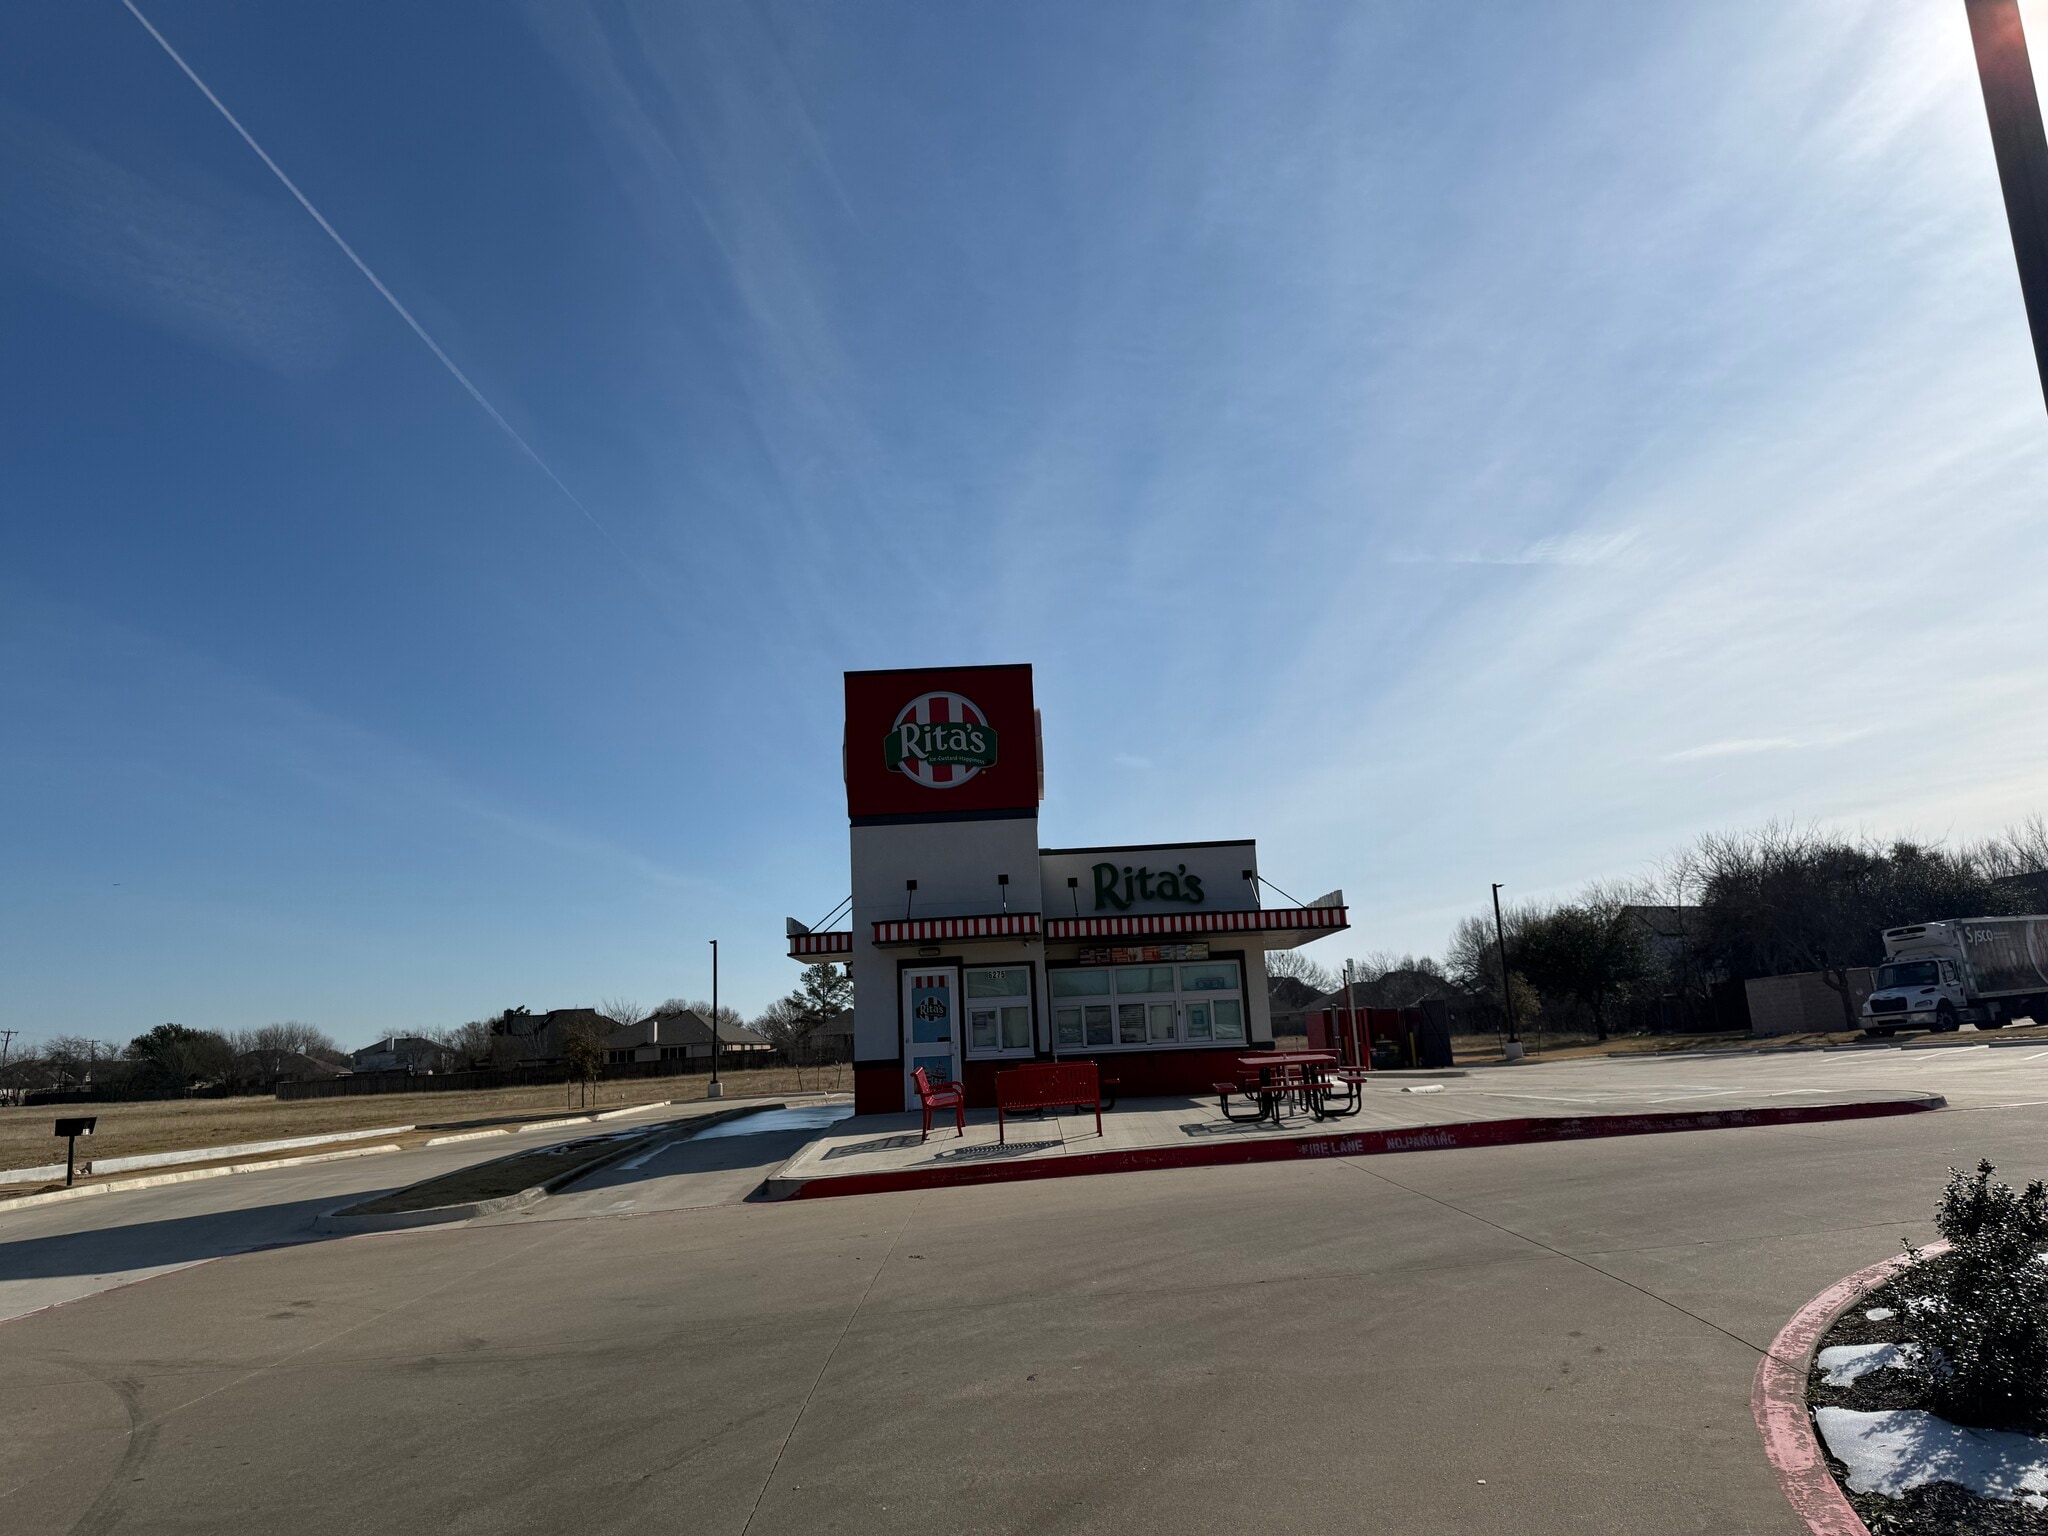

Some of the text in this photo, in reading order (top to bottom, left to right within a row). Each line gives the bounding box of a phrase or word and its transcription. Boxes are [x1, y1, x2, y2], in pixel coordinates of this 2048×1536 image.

[899, 723, 986, 759] Rita's
[1092, 863, 1204, 911] Rita's
[1965, 926, 1993, 946] Sysco
[920, 1004, 944, 1015] Rita's
[1300, 1134, 1456, 1155] FIRE LANE NO PARKING
